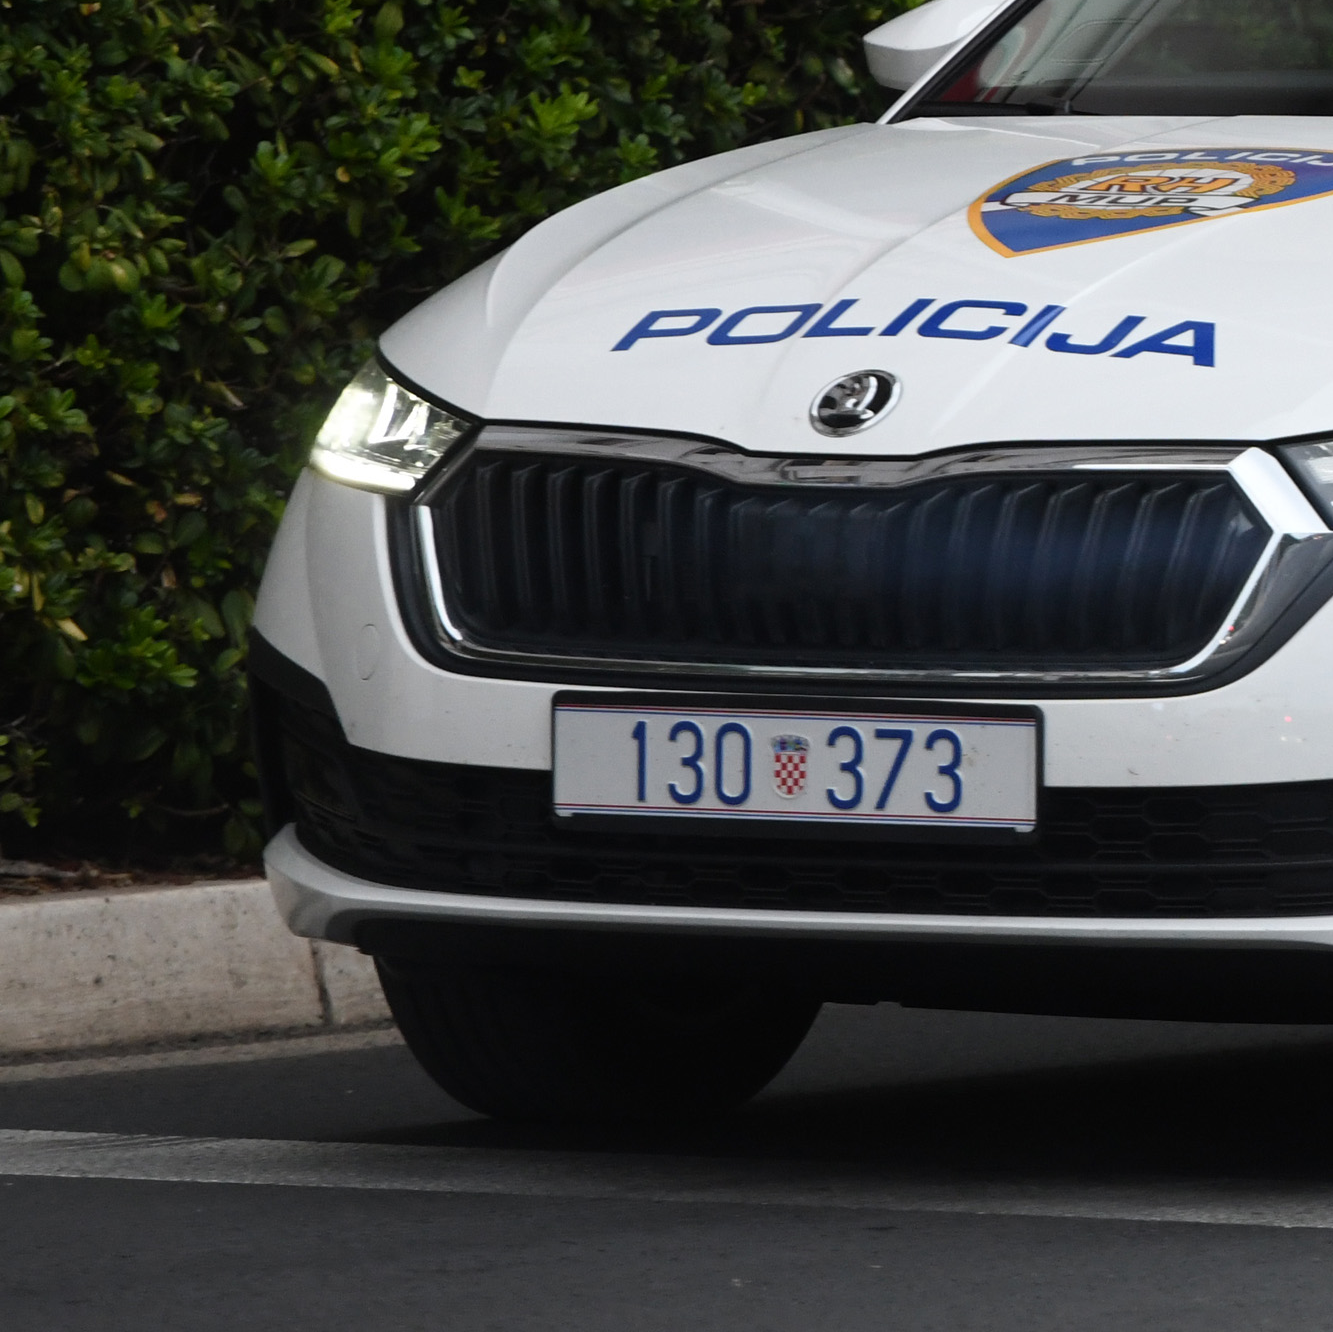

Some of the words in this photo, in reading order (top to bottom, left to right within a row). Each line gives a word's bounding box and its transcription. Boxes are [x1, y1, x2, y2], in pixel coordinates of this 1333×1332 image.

[1047, 193, 1200, 206] MUP
[1088, 174, 1237, 194] RH
[610, 298, 1216, 368] POLICIJA
[632, 719, 752, 806] 130
[826, 725, 964, 814] 373
